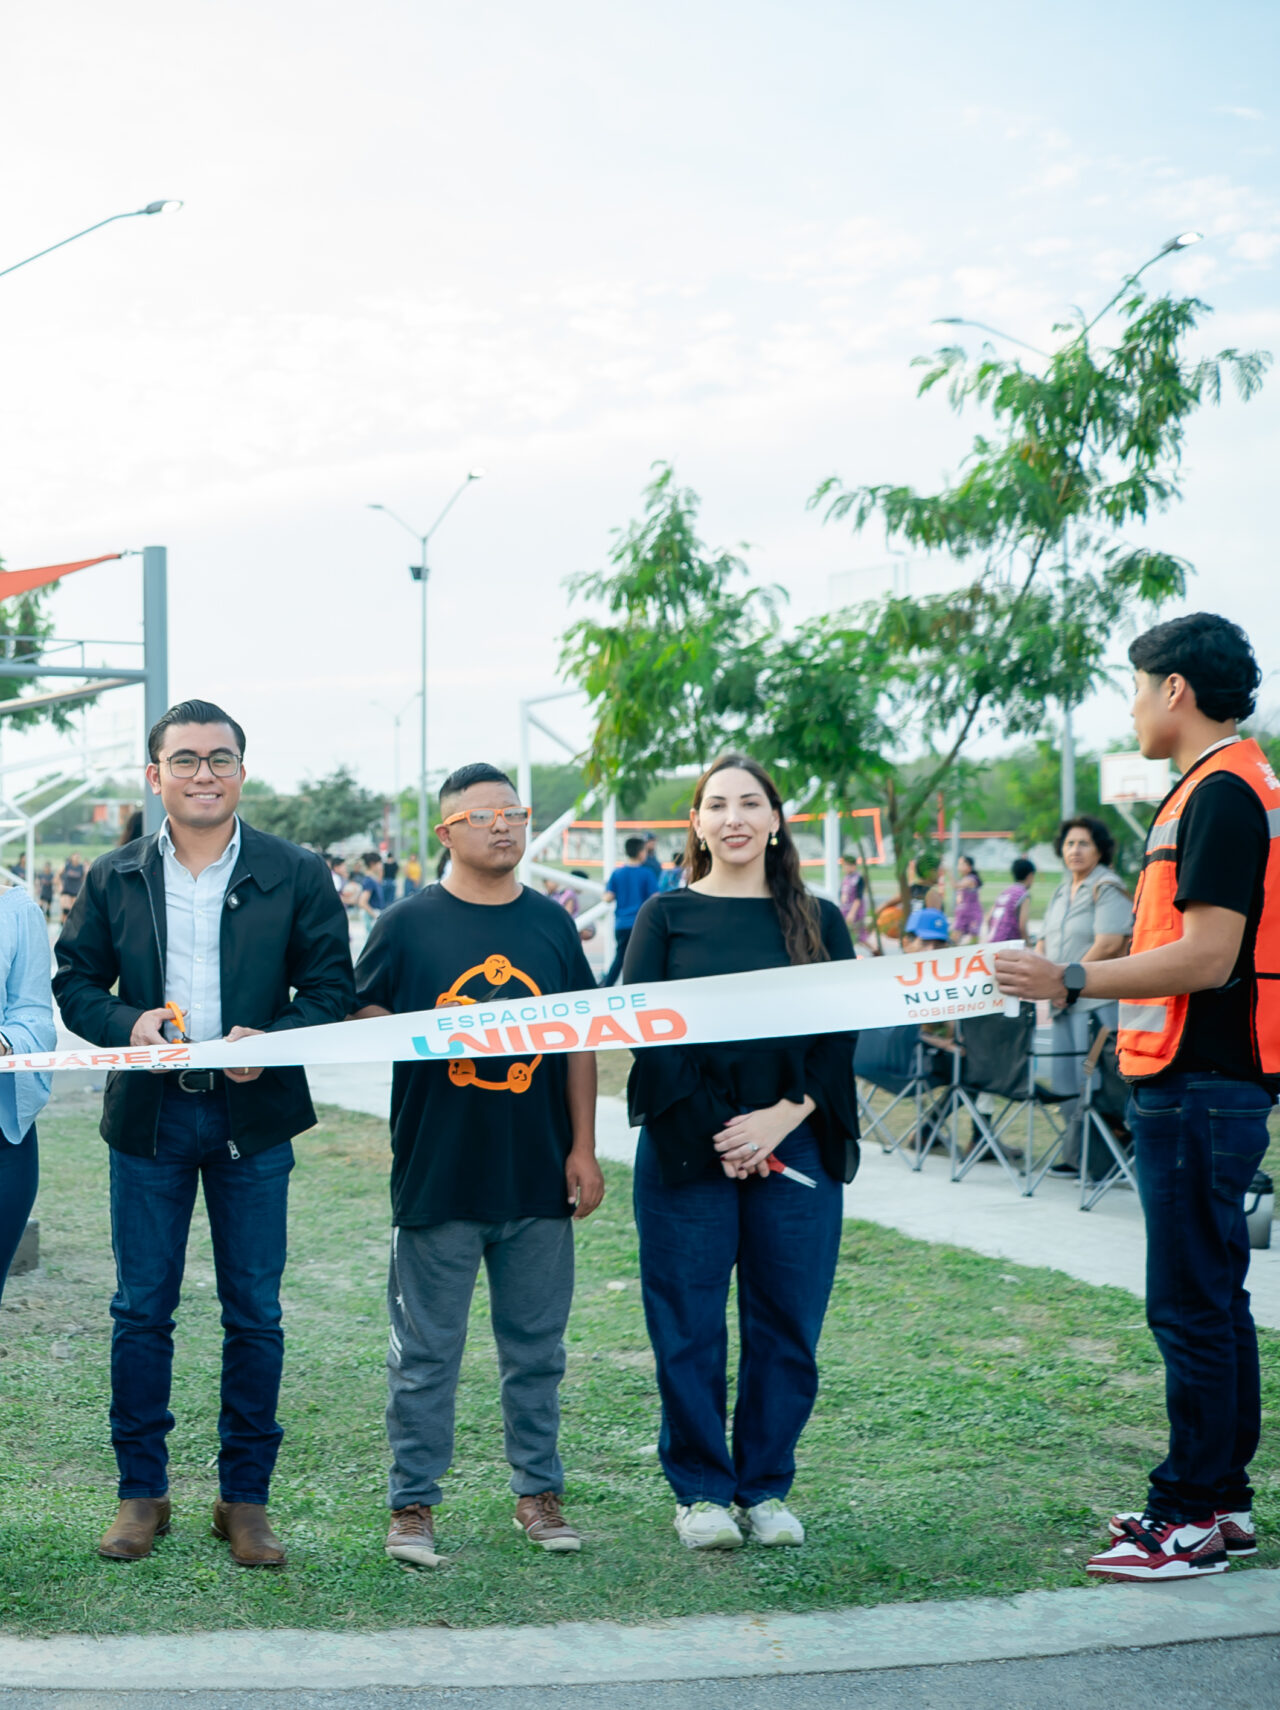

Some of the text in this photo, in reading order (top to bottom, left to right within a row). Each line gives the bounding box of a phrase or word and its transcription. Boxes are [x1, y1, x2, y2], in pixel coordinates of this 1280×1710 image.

[894, 949, 1000, 987] JUÁ
[437, 993, 647, 1031] ESPACIOS DE
[904, 983, 994, 1005] NUEVO
[908, 1001, 986, 1018] GOBIERNO
[411, 1008, 688, 1057] UNIDAD
